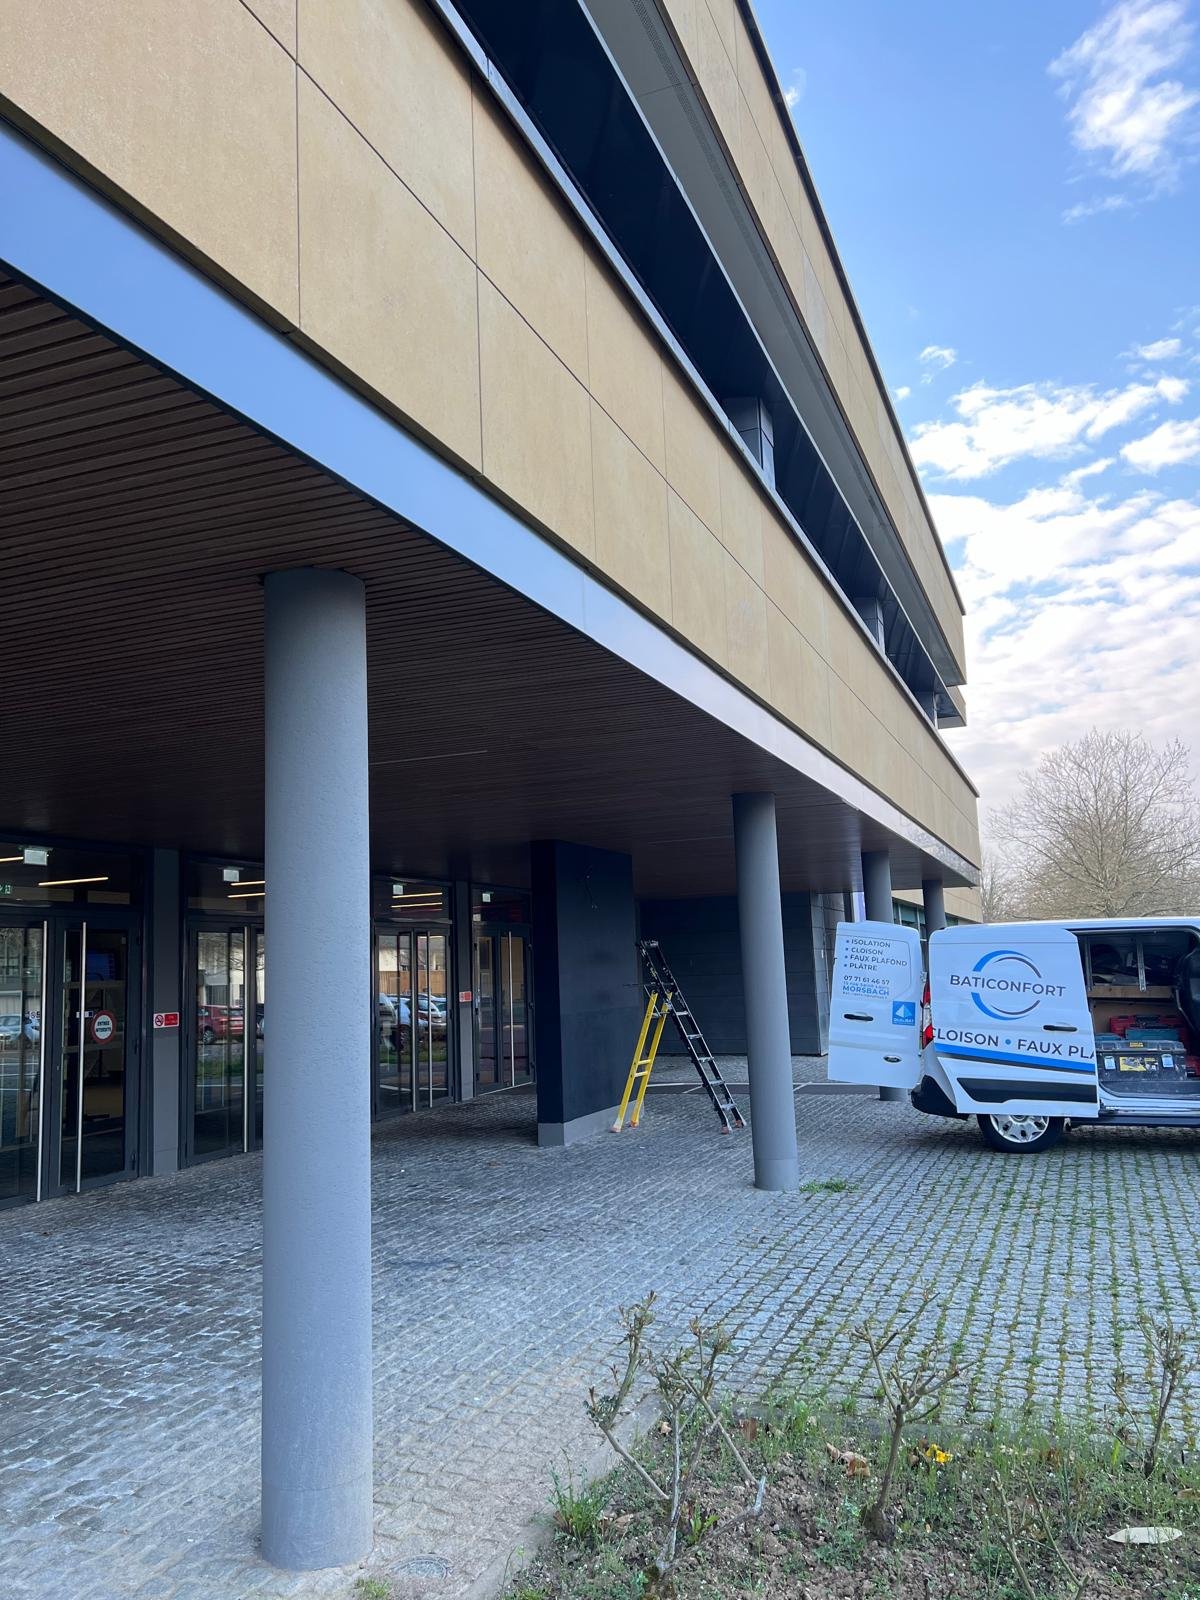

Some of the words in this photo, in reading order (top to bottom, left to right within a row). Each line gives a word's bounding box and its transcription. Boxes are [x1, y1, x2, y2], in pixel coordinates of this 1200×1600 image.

[851, 939, 891, 948] ISOLATION
[851, 947, 883, 955] CLOISON
[850, 954, 870, 963] FAUX
[871, 956, 908, 967] PLAFOND
[842, 985, 889, 996] MORSBACH
[950, 974, 1066, 997] BATICONFORT
[1017, 1038, 1063, 1056] FAUX
